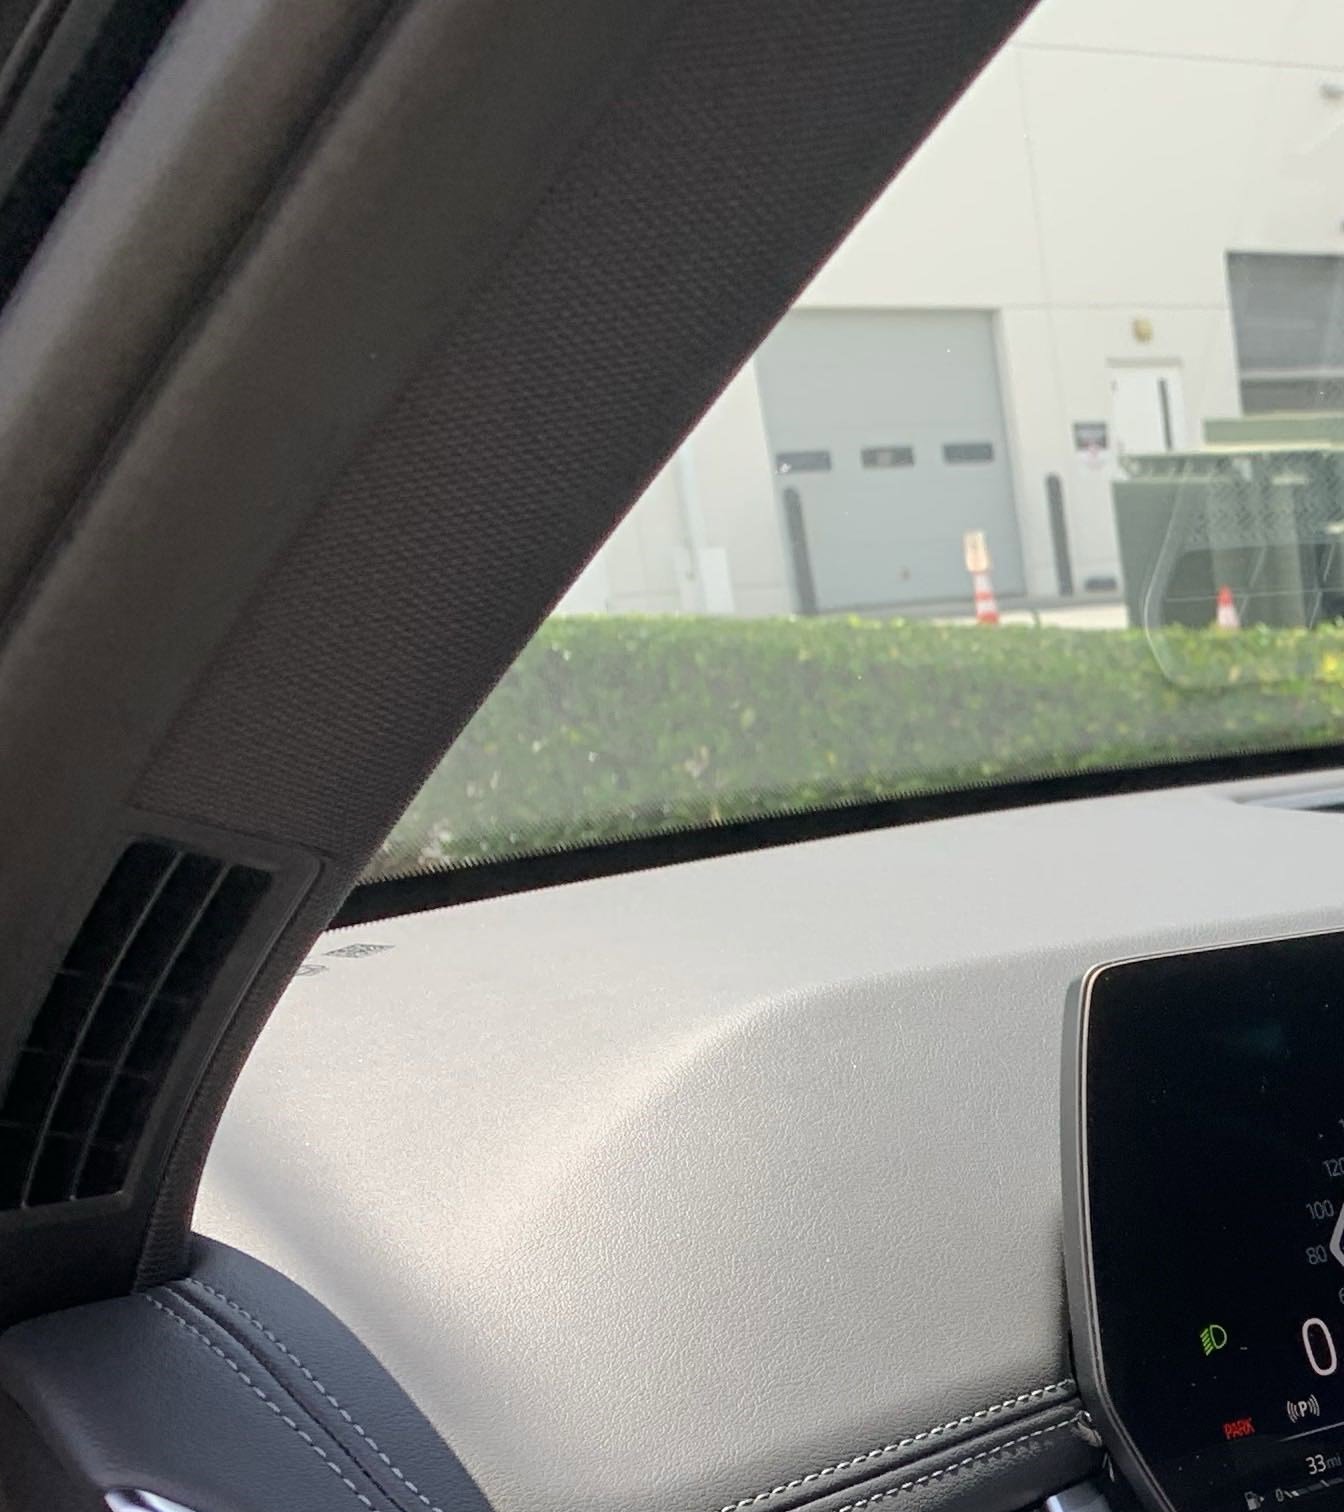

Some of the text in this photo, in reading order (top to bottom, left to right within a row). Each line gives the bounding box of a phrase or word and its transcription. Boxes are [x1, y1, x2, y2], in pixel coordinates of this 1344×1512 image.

[1305, 1200, 1335, 1220] 100
[1305, 1244, 1328, 1265] 80
[1301, 1317, 1337, 1376] 0
[1222, 1418, 1255, 1440] PARK
